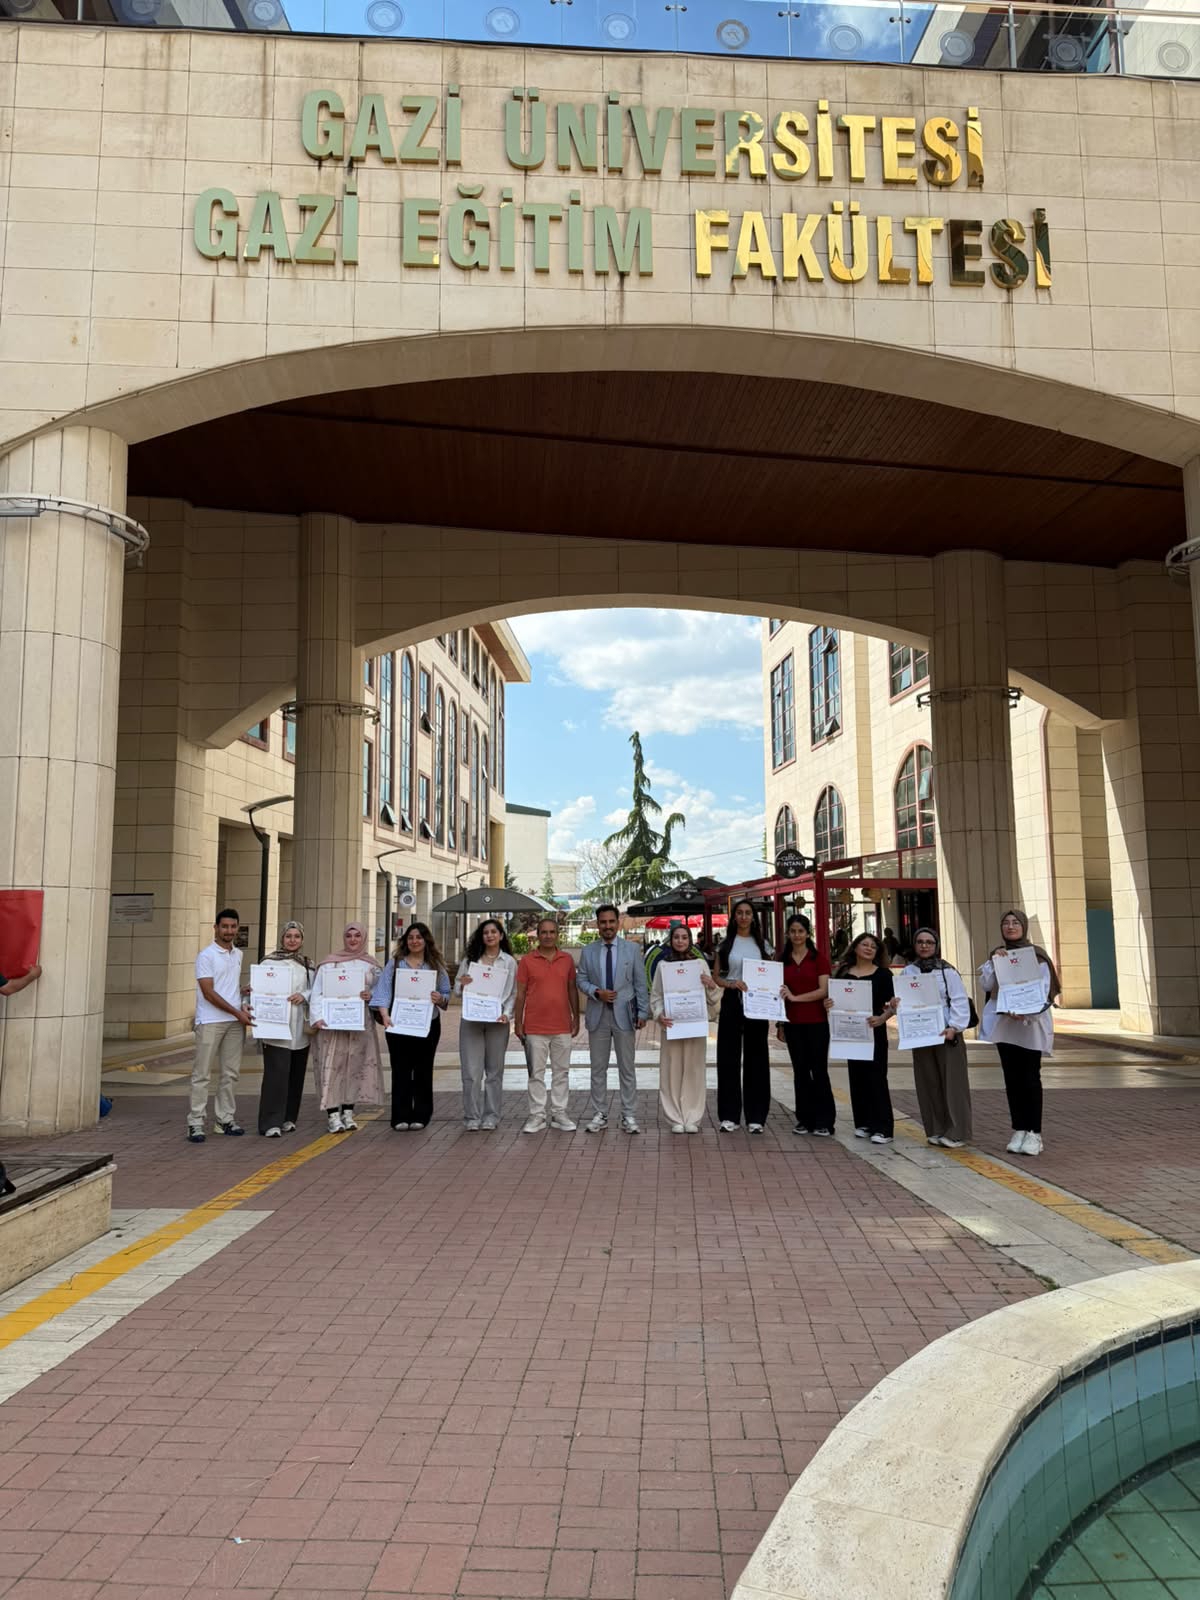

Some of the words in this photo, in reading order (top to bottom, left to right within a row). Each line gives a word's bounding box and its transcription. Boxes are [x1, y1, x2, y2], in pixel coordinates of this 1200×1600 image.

[301, 84, 462, 167] GAZİ
[504, 86, 985, 188] ÜNİVERSİTESİ
[193, 179, 359, 266] GAZİ
[402, 182, 654, 277] EĞİTİM
[694, 200, 1052, 290] FAKÜLTESİ
